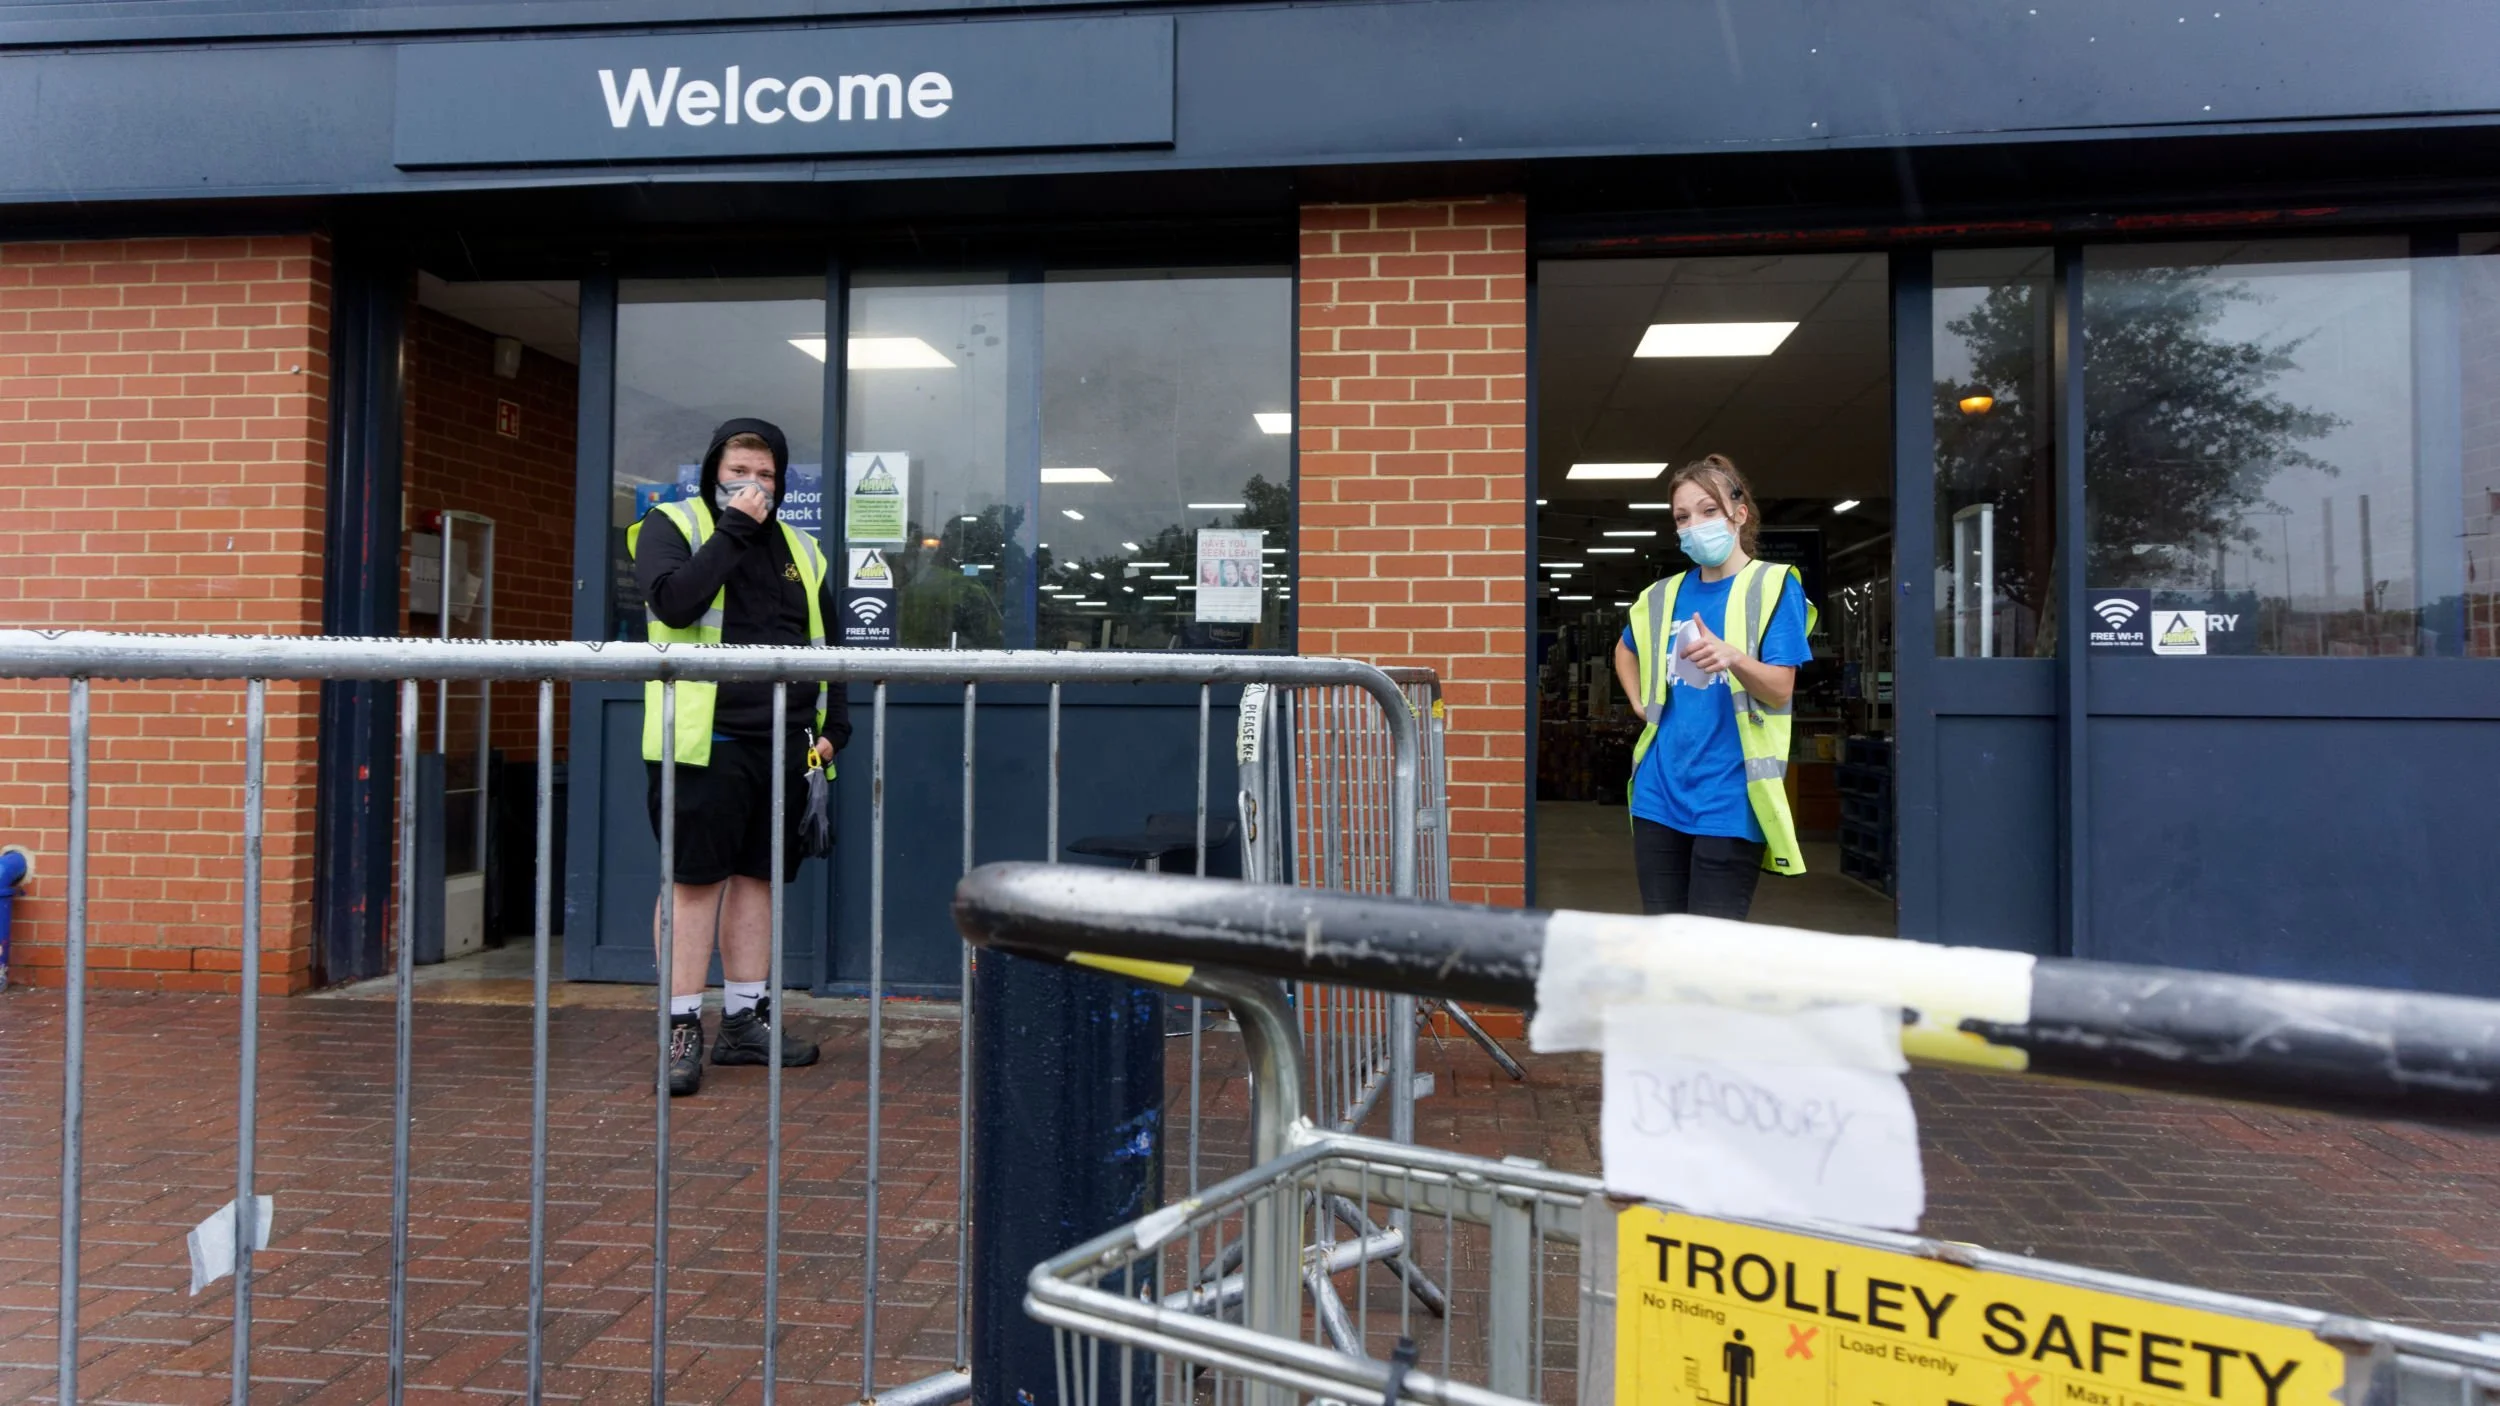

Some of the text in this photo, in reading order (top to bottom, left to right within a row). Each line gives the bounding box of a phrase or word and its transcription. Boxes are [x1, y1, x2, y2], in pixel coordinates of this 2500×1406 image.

[598, 65, 953, 128] Welcome
[777, 507, 814, 520] back
[1200, 539, 1247, 548] HAVE YOU
[1200, 548, 1225, 557] SEEN
[845, 627, 890, 635] FREE WI-FI
[2204, 614, 2239, 632] RY
[2090, 632, 2144, 641] FREE WI-FI
[1243, 703, 1257, 741] PLEASE
[1643, 1292, 1726, 1326] No Riding
[1645, 1234, 2300, 1406] TROLLEY SAFETY
[1840, 1335, 1959, 1377] Load Evenly
